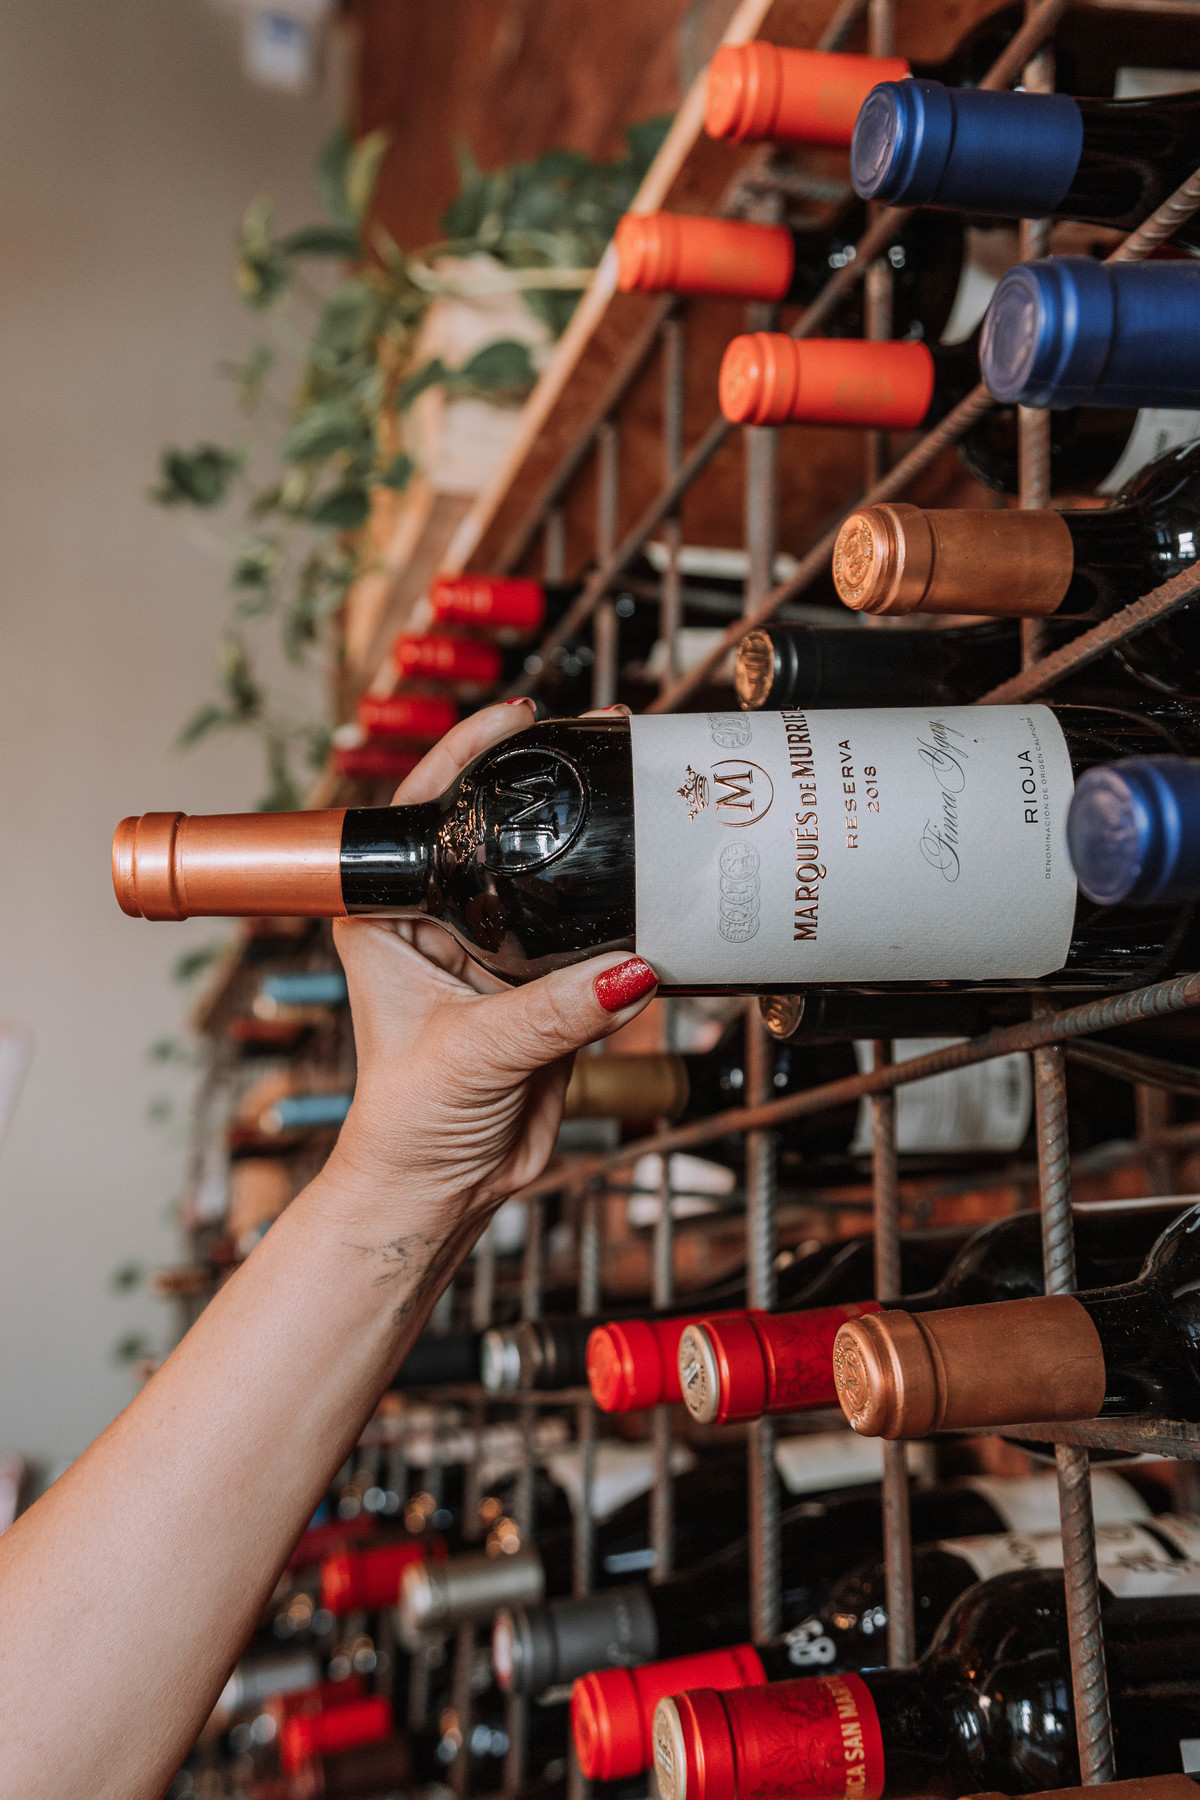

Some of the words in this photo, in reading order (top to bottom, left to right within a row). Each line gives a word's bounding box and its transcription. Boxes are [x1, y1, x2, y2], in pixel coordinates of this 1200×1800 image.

[713, 769, 756, 816] M
[800, 783, 817, 807] DE
[838, 739, 859, 848] RESERVA
[864, 765, 881, 813] 2018
[1017, 750, 1038, 823] RIOJA
[1039, 753, 1048, 785] ORIGEN
[1042, 787, 1049, 800] DE
[494, 762, 559, 841] M
[919, 791, 960, 882] Finca
[1043, 803, 1052, 880] DENOMINACIÓN
[788, 812, 827, 941] MARQUÉS
[841, 1721, 865, 1762] SAN
